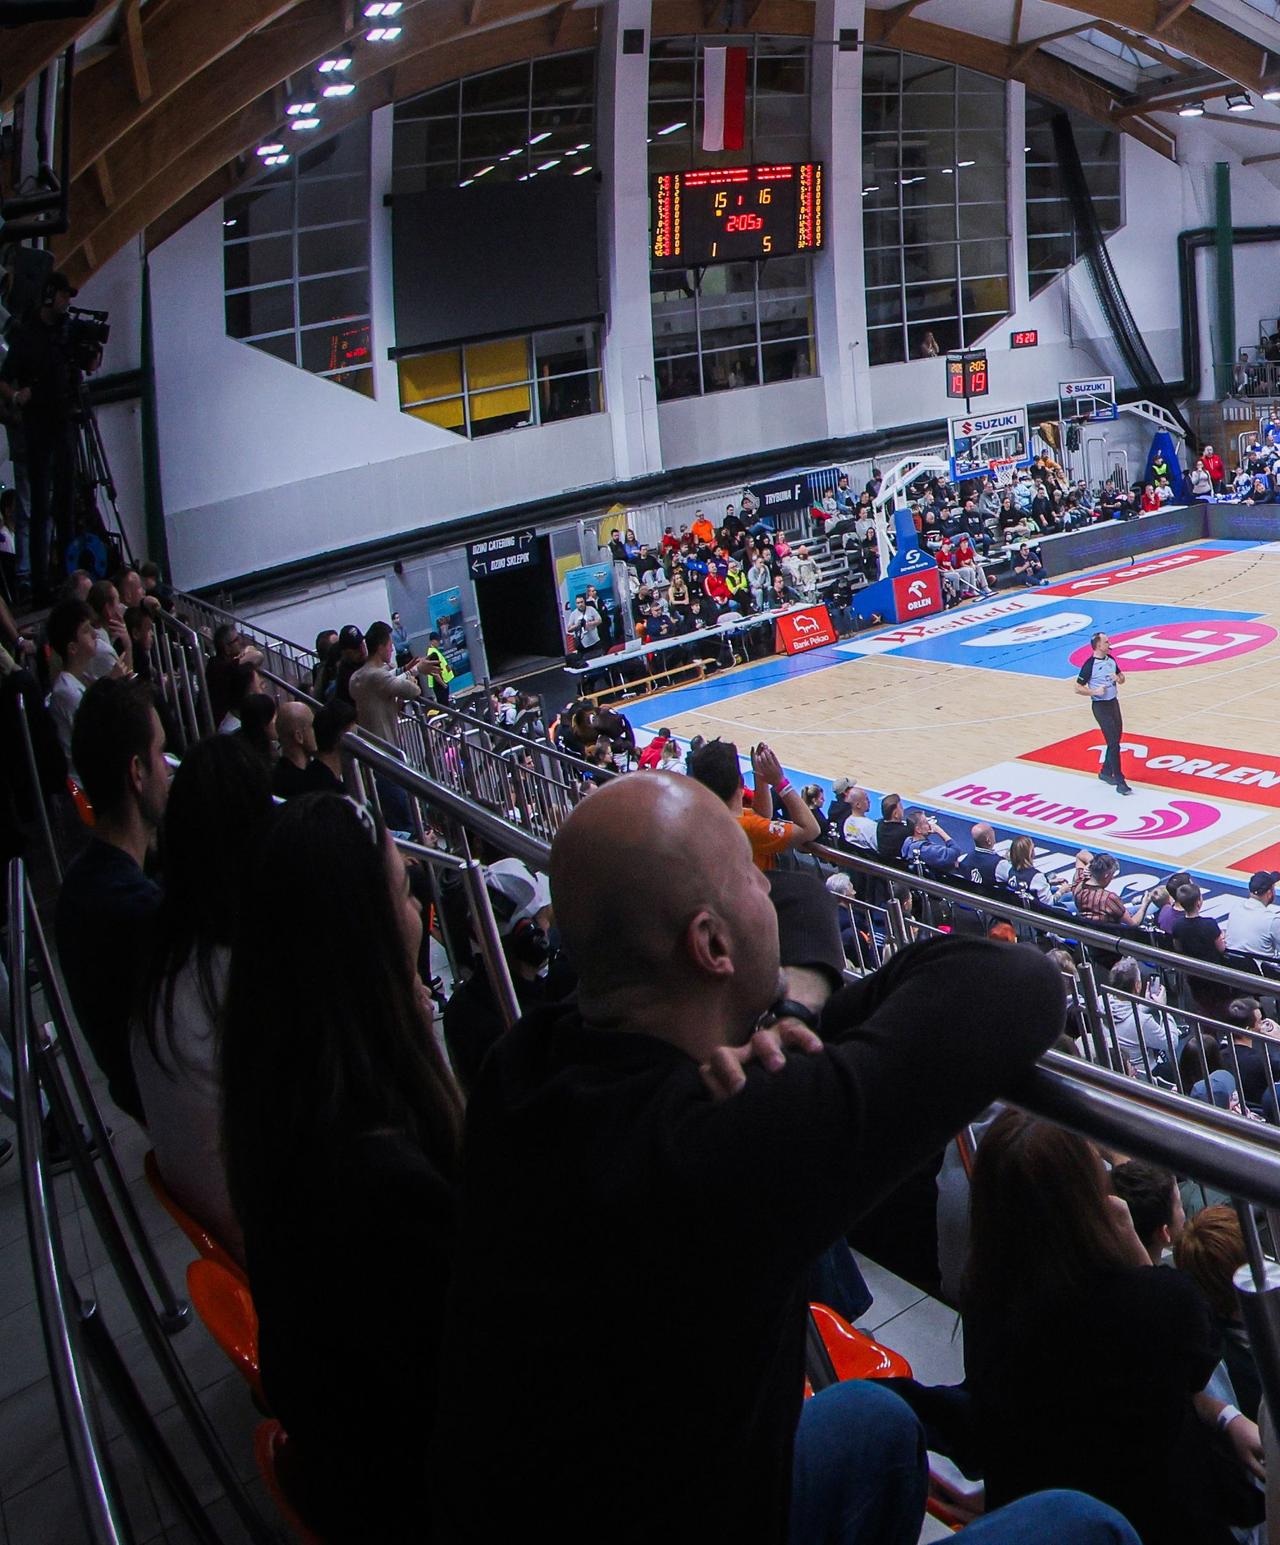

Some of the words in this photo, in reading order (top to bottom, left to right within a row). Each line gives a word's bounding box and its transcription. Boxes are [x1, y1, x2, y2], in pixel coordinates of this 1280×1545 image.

[714, 192, 727, 208] 15
[758, 188, 771, 204] 16
[762, 236, 771, 252] 5
[972, 372, 985, 392] 19
[1075, 383, 1105, 393] SUZUKI
[975, 415, 1017, 431] SUZUKI
[795, 484, 801, 500] F
[908, 597, 931, 610] ORLEN
[873, 601, 1031, 644] Westfield
[793, 639, 810, 650] Bank
[810, 634, 830, 646] Pekao
[942, 782, 1118, 831] netuno
